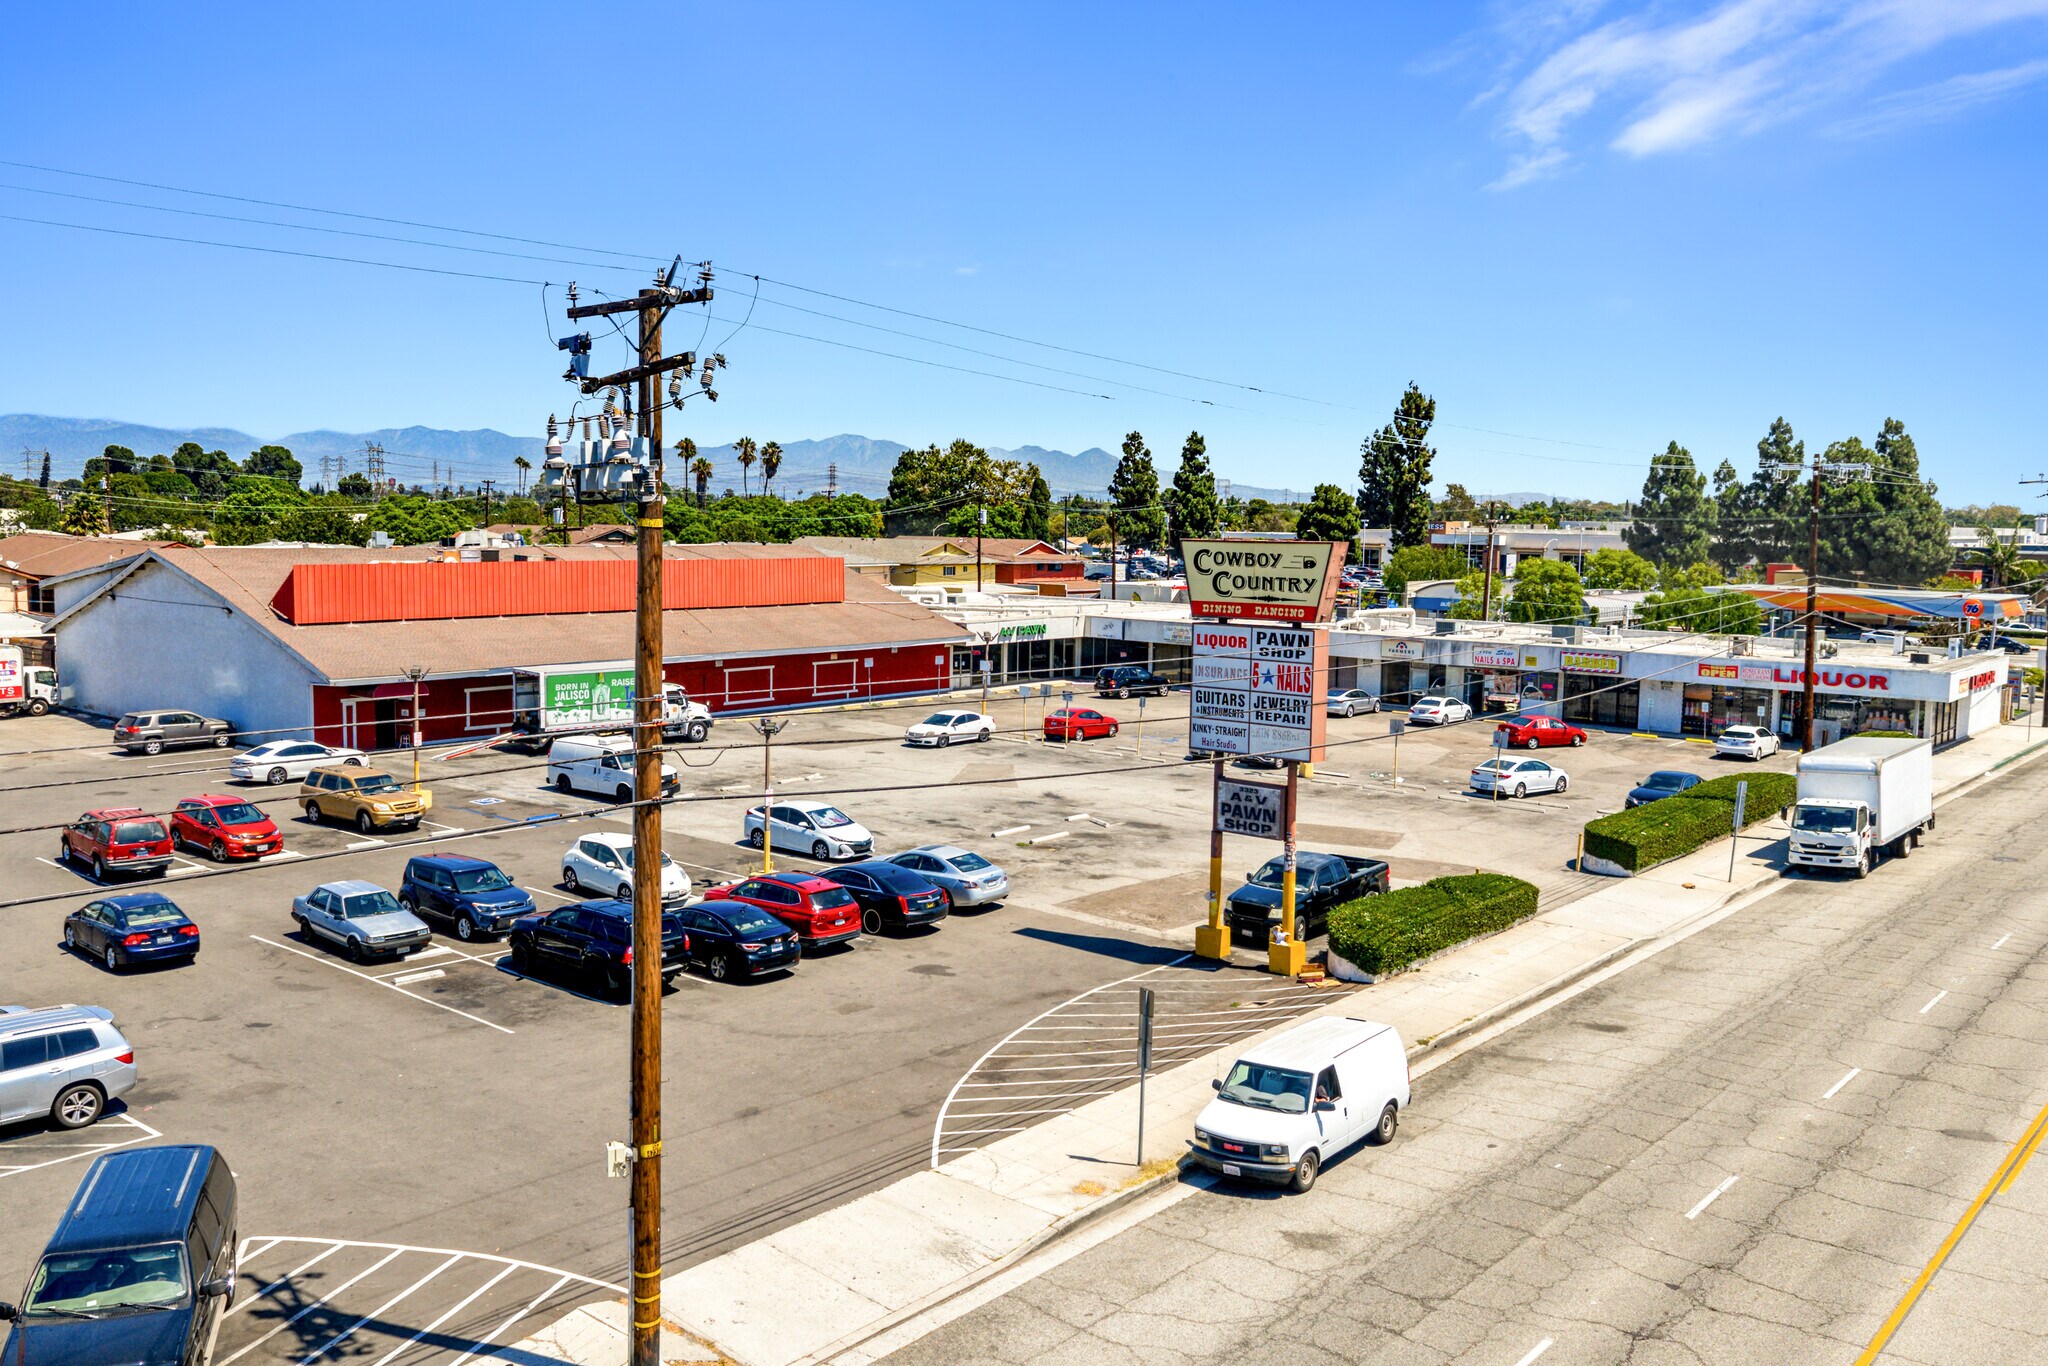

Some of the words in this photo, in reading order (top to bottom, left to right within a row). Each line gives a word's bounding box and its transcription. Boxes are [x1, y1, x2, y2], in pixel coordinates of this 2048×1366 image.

[1194, 549, 1283, 575] COWBOY
[1212, 571, 1316, 597] COUNTRY
[1202, 604, 1242, 614] DINING
[1255, 606, 1305, 617] DANCING
[1966, 605, 1979, 614] 76
[1017, 624, 1046, 635] PAWN
[1196, 634, 1247, 649] LIQUOR
[1257, 632, 1310, 647] PAWN
[1259, 647, 1306, 659] SHOP
[1475, 656, 1494, 664] NAILS
[1564, 656, 1617, 670] BARBER
[1252, 663, 1259, 688] 5
[1277, 665, 1311, 694] NAILS
[1701, 668, 1736, 678] OPEN
[1774, 669, 1888, 690] LIQUOR
[555, 683, 578, 691] BORN
[612, 678, 635, 686] RAISE
[555, 690, 590, 701] JALISCO
[1196, 690, 1245, 707] GUITARS
[1254, 696, 1308, 713] JEWELRY
[1201, 706, 1244, 718] INSTRUMENTS
[1256, 711, 1306, 725] REPAIR
[1202, 738, 1215, 747] Hair
[1217, 739, 1236, 750] Studio
[1221, 803, 1276, 823] PAWN
[1224, 819, 1272, 834] SHOP
